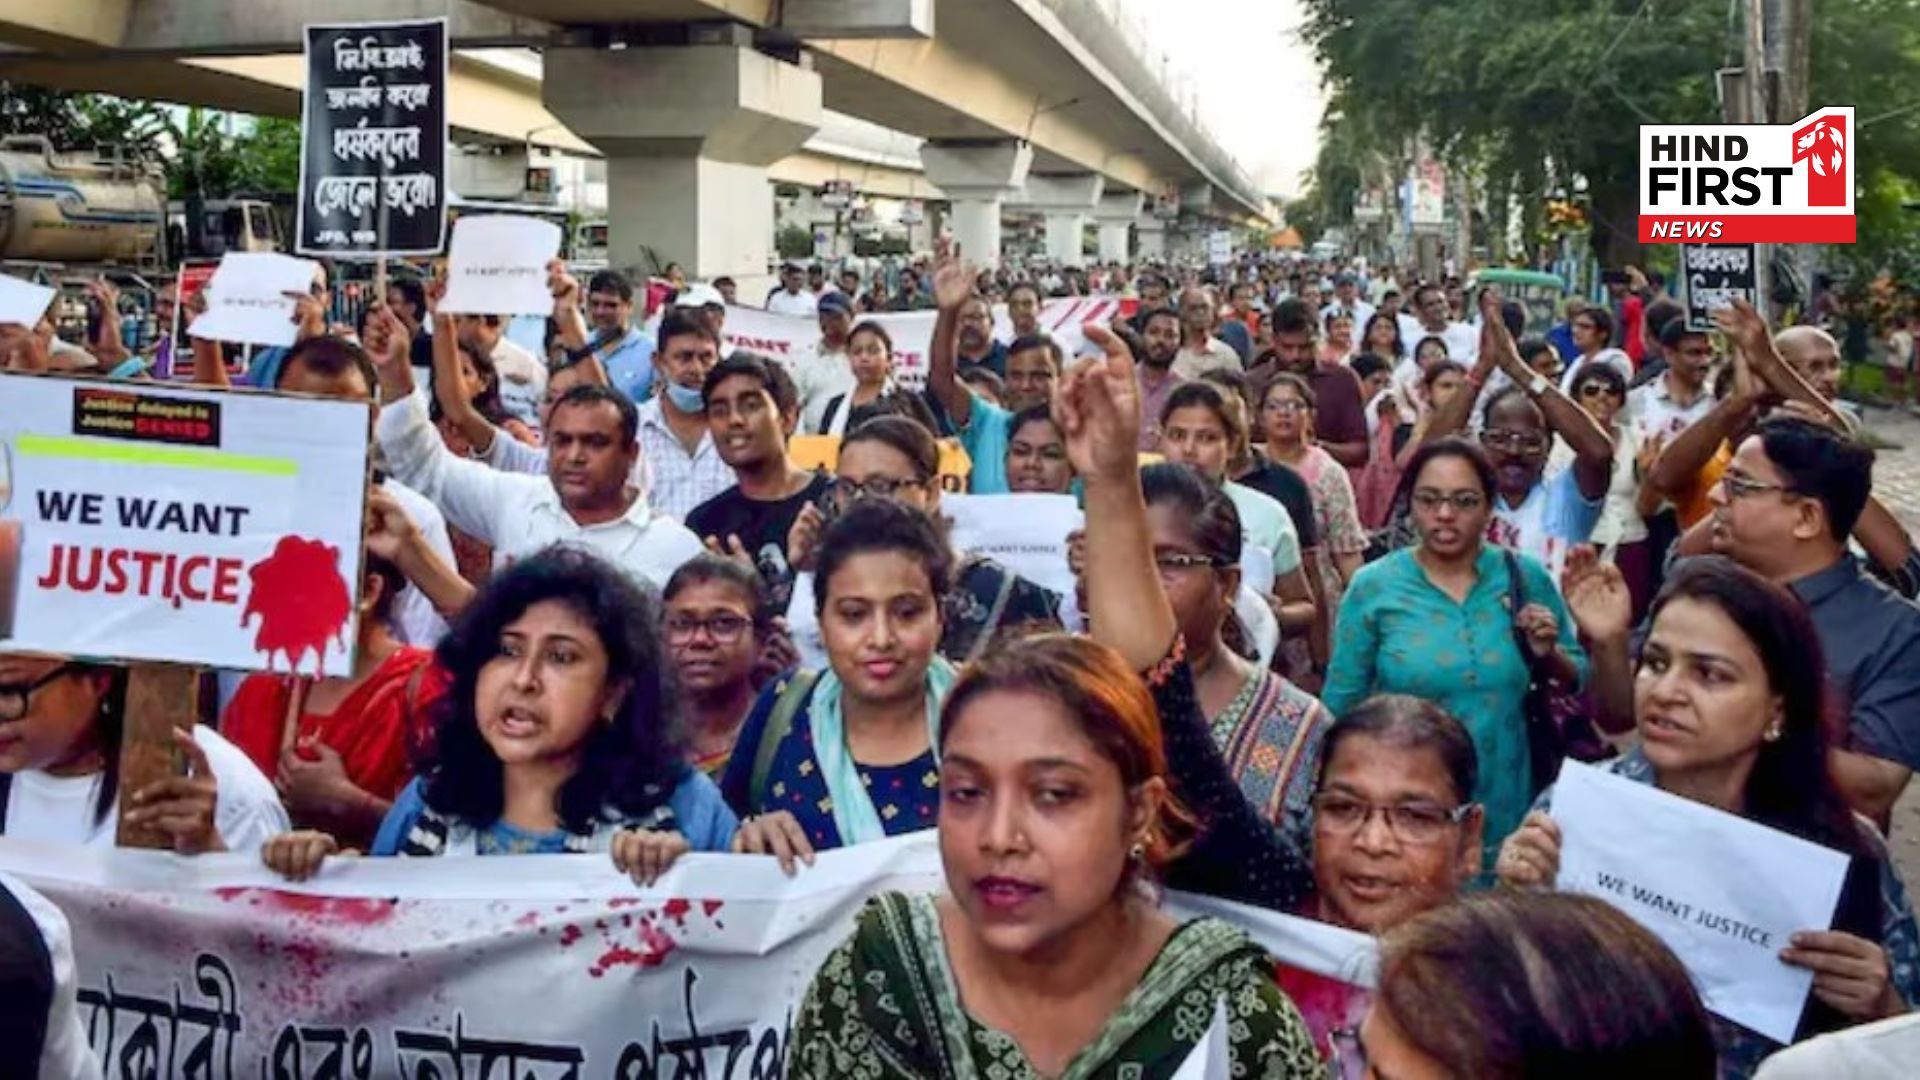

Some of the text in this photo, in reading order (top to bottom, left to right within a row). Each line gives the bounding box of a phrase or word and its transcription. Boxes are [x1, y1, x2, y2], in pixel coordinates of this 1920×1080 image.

[333, 116, 421, 169] ধর্ষকদের
[314, 175, 377, 217] জেলে
[81, 397, 134, 412] Justice
[136, 402, 192, 418] delayed
[81, 414, 211, 439] Justice DENIED
[37, 490, 249, 536] WE WANT
[38, 545, 242, 604] JUSTICE
[1597, 871, 1773, 949] WE WANT JUSTICE
